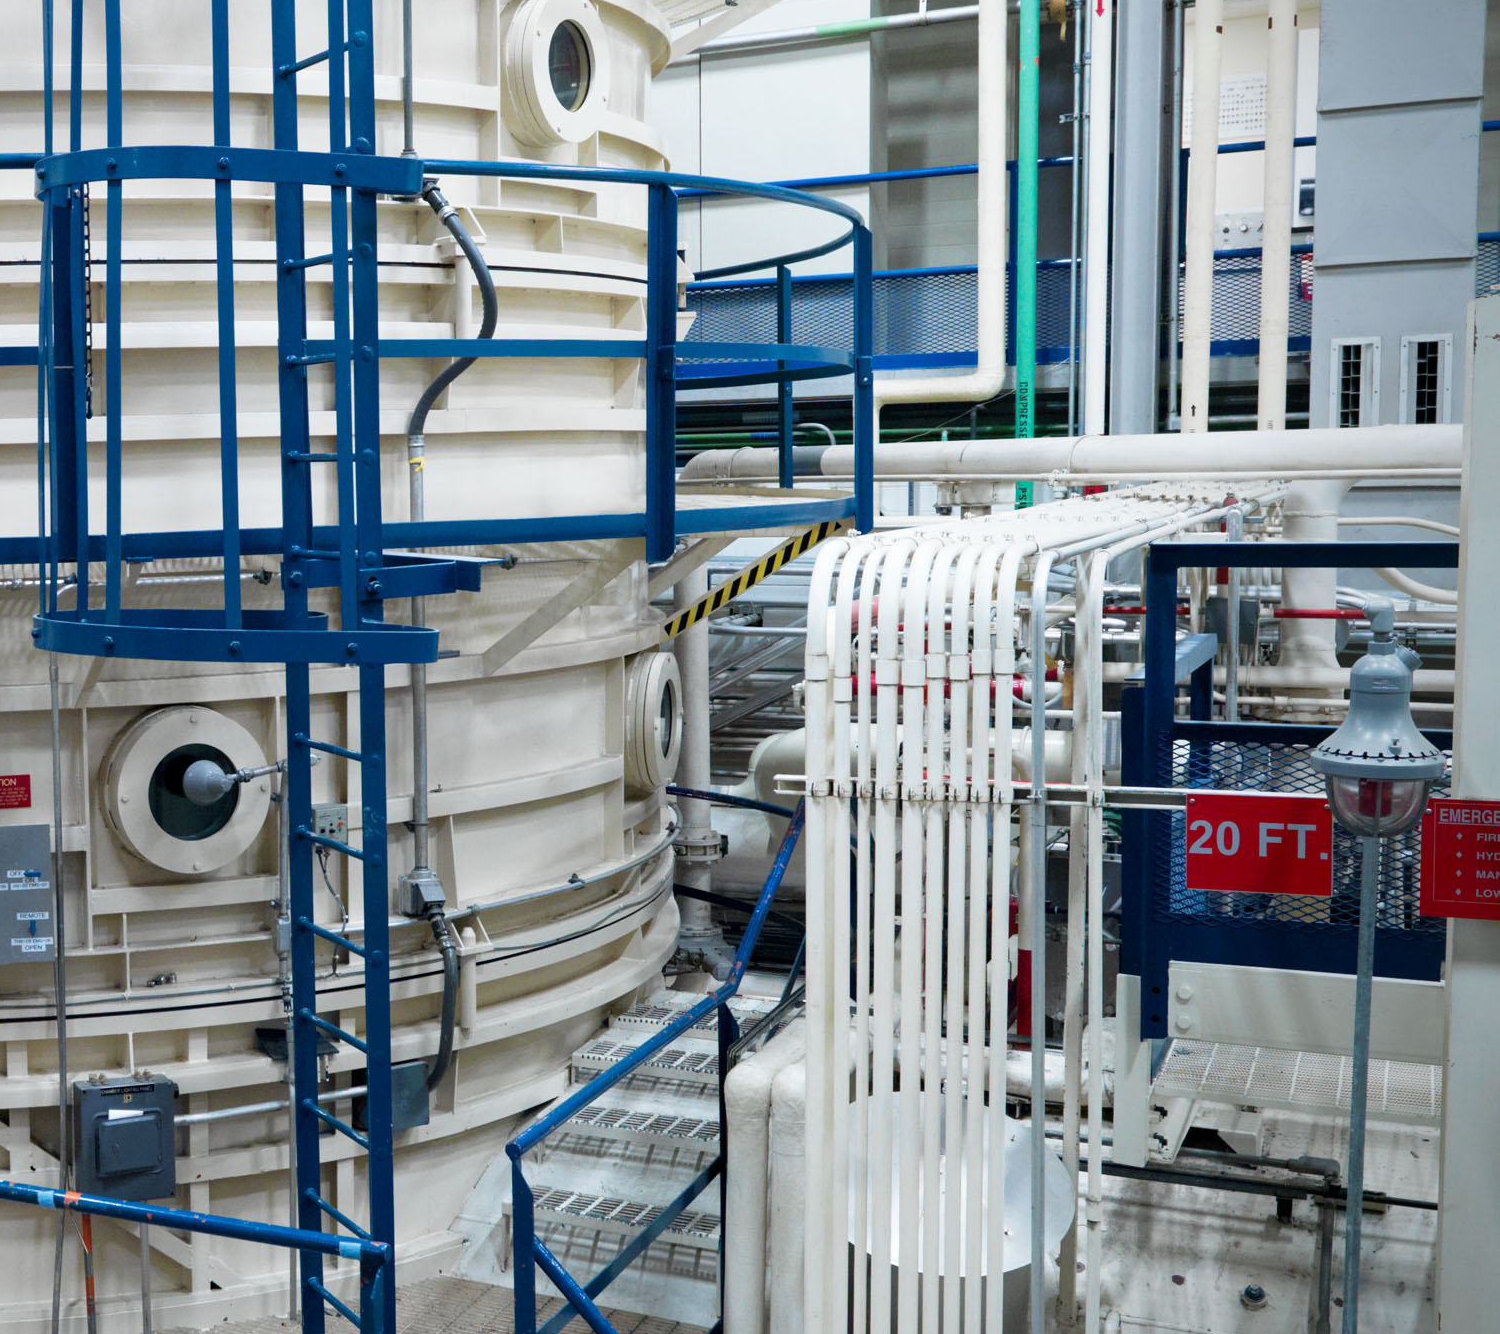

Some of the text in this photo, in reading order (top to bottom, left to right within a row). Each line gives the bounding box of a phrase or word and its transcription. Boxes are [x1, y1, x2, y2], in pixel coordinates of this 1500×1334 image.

[1440, 808, 1500, 824] EMERGE
[1188, 819, 1328, 860] 20 FT.
[24, 944, 43, 952] OPEN
